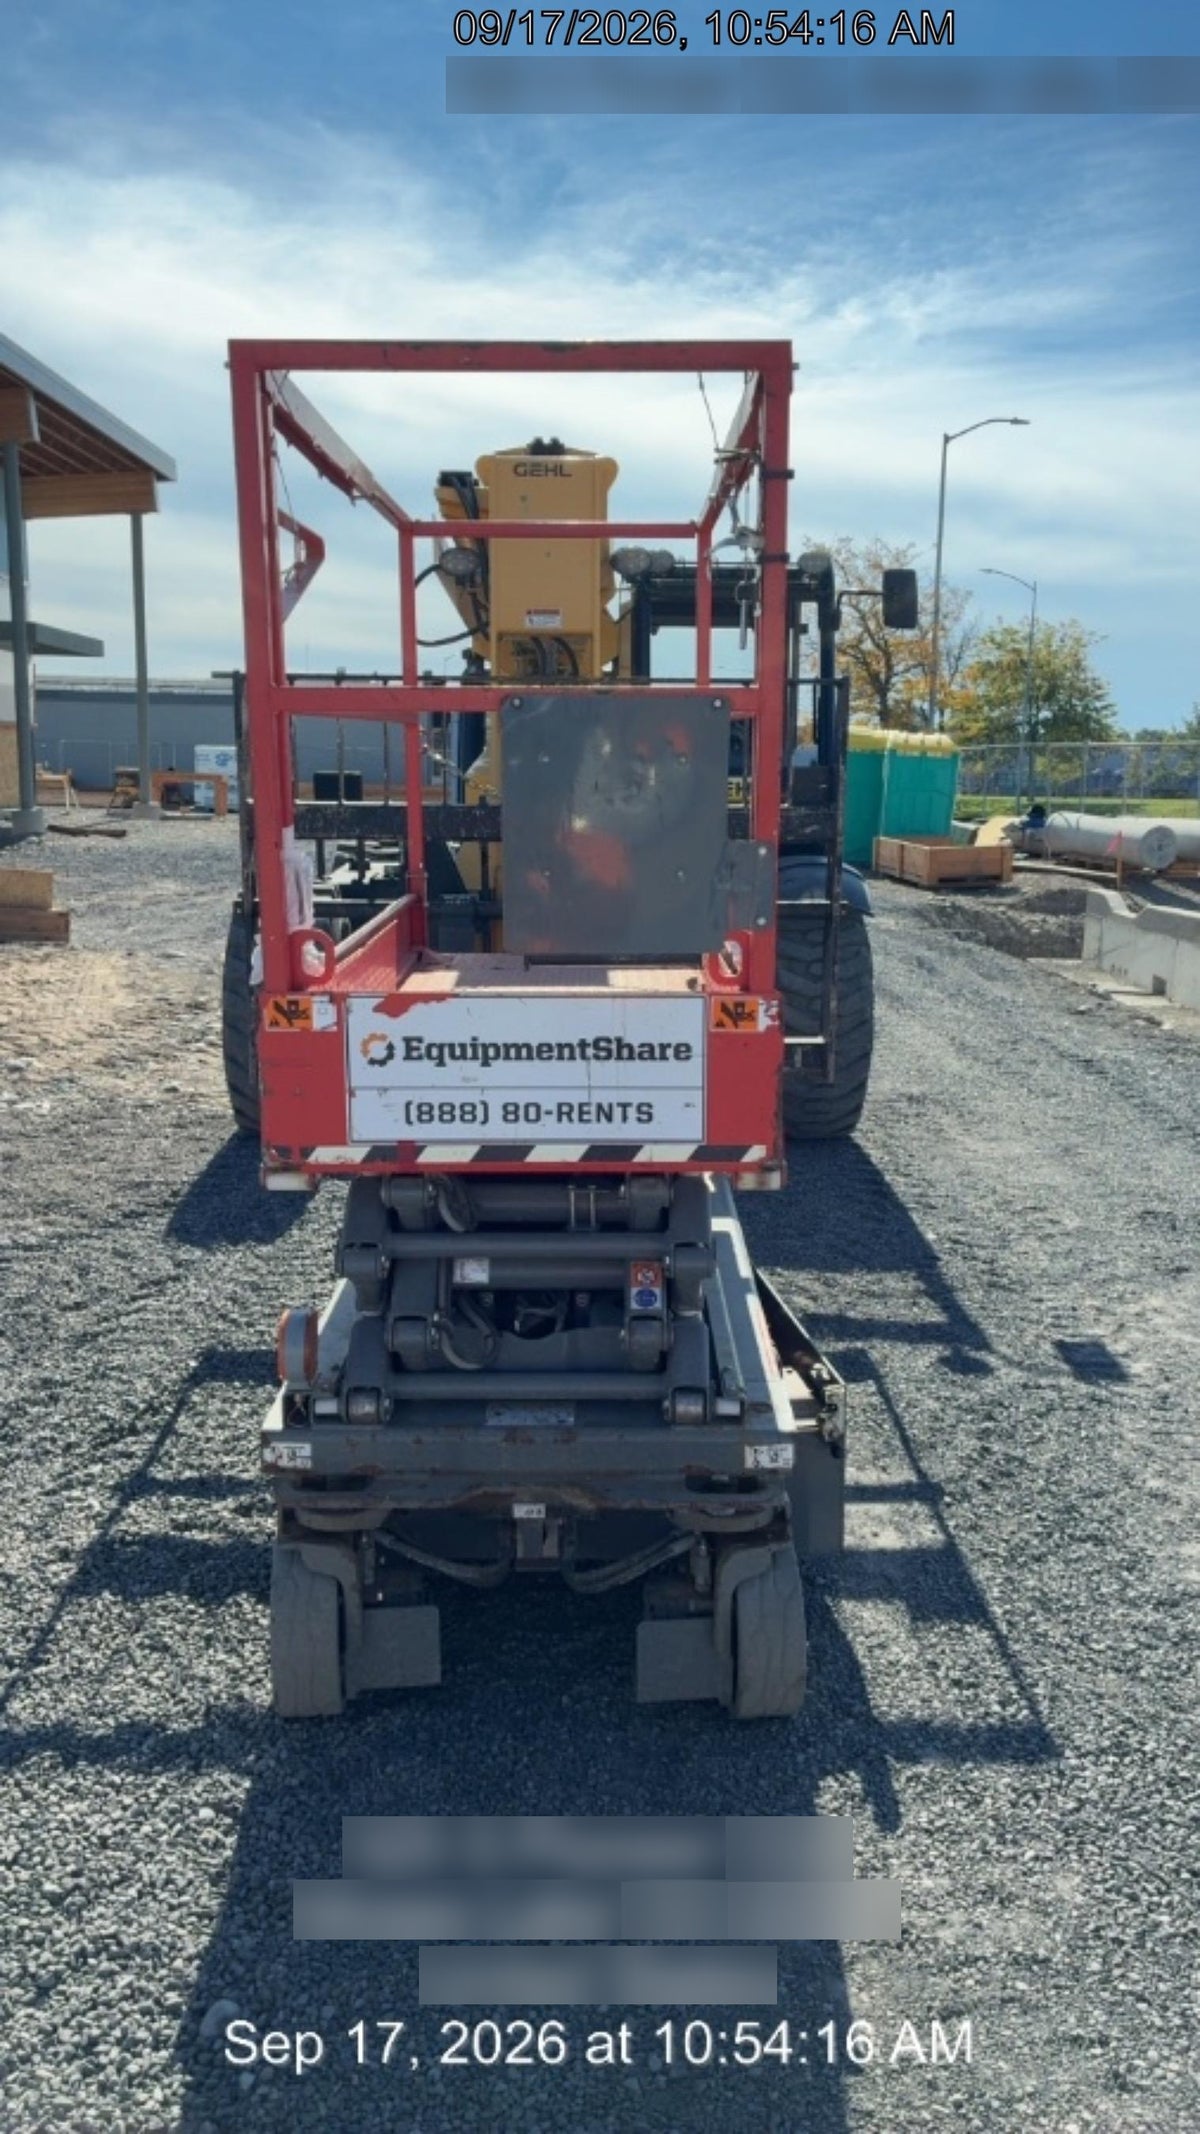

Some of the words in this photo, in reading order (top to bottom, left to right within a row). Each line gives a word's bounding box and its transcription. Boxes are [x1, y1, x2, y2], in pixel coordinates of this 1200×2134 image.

[513, 462, 573, 478] GEHL
[402, 1036, 693, 1067] EquipmentShare
[404, 1101, 490, 1125] (888)
[501, 1102, 654, 1124] 80-RENTS
